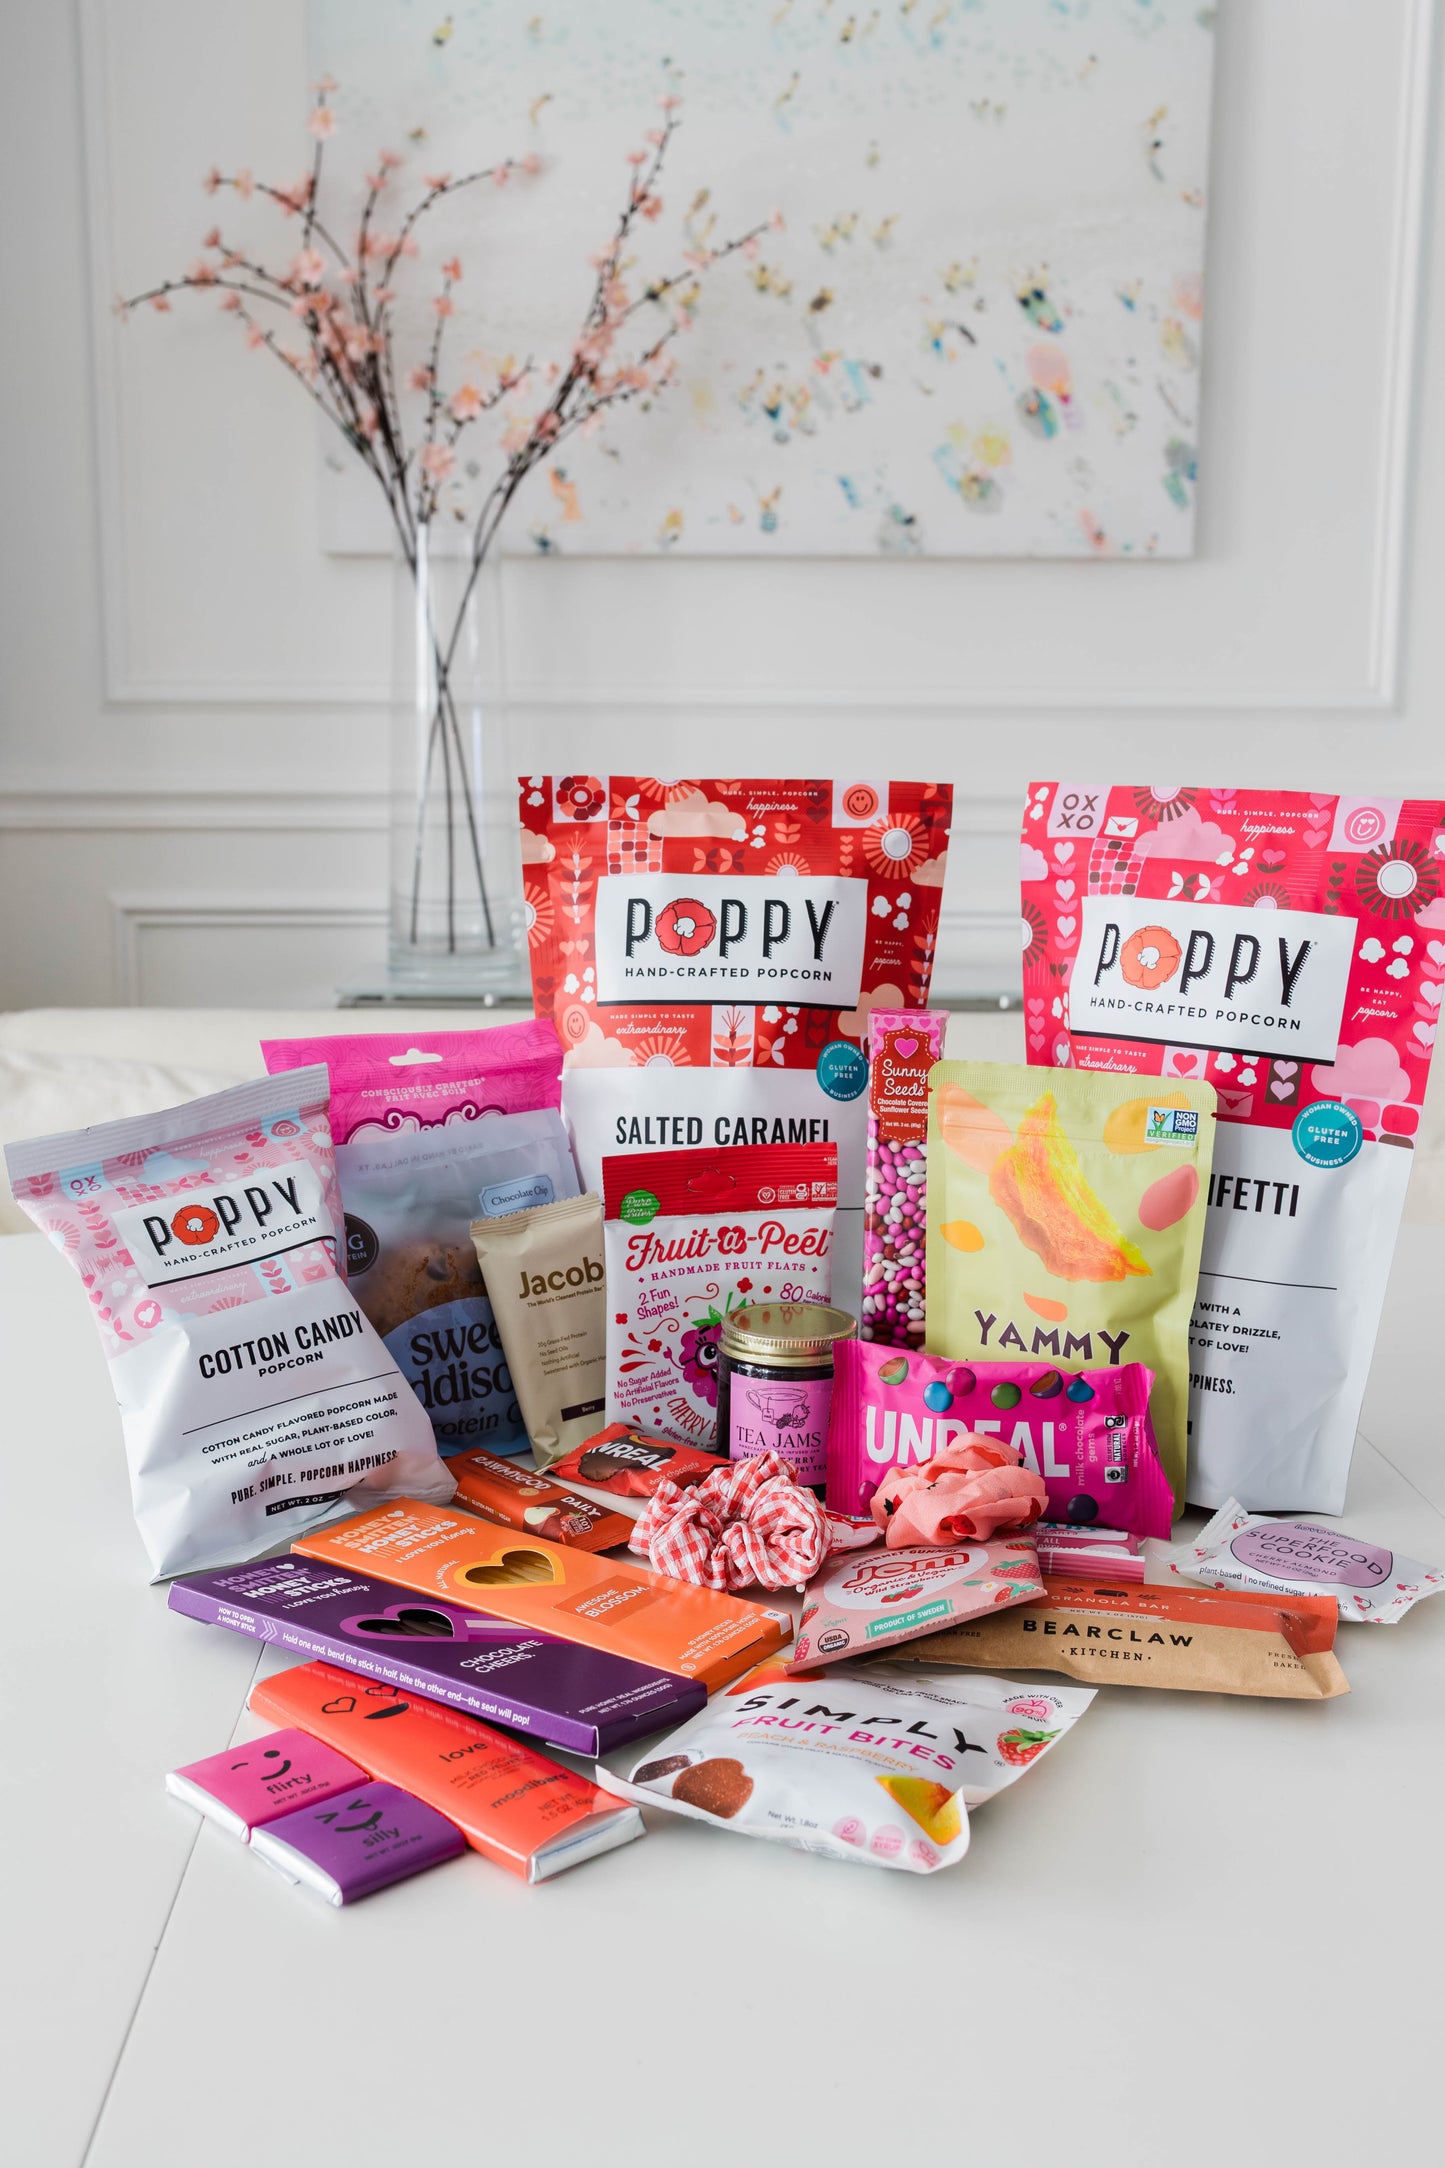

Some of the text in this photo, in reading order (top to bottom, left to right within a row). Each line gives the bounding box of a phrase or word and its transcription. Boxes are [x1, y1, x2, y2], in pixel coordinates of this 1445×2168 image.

[1280, 811, 1319, 819] POPCORN
[1241, 820, 1295, 841] happiness
[626, 898, 835, 962] POPPY
[626, 966, 832, 981] HAND-CRAFTED POPCORN
[1094, 923, 1311, 1008] POPPY
[1090, 997, 1301, 1031] HAND-CRAFTED POPCORN
[1352, 1006, 1398, 1021] popcorn
[616, 1021, 687, 1044] extraordinary
[882, 1059, 928, 1084] Sunny
[361, 1085, 433, 1098] CONSCIOUSLY
[884, 1078, 924, 1096] Seeds
[878, 1098, 906, 1106] Chocolate
[1175, 1119, 1196, 1127] GMO
[1177, 1112, 1196, 1120] NON
[1302, 1103, 1358, 1127] WOMAN OWNED
[616, 1116, 702, 1145] SALTED
[1150, 1131, 1193, 1140] VERIFIED
[1308, 1127, 1348, 1138] GLUTEN
[1314, 1136, 1340, 1145] FREE
[1305, 1153, 1343, 1166] BUSINESS
[491, 1185, 548, 1206] Chocolate Chip
[143, 1177, 303, 1256] POPPY
[164, 1216, 317, 1267] HAND-CRAFTED POPCORN
[519, 1257, 604, 1299] Jacob
[651, 1261, 805, 1281] HANDMADE FRUIT FLATS
[639, 1287, 671, 1306] 2 Fun
[780, 1283, 803, 1303] 80
[637, 1296, 679, 1320] Shapes!
[1200, 1302, 1229, 1313] WITH
[410, 1322, 503, 1366] swee
[974, 1310, 1130, 1365] YAMMY
[1233, 1326, 1281, 1340] DRIZZLE,
[199, 1311, 364, 1379] COTTON CANDY
[1198, 1339, 1249, 1353] OF LOVE!
[258, 1351, 324, 1377] POPCORN
[626, 1385, 654, 1397] Artificial
[655, 1378, 679, 1389] Flavors
[629, 1376, 648, 1386] Sugar
[651, 1368, 671, 1380] Added
[632, 1389, 677, 1405] Preservatives
[202, 1392, 398, 1454] COTTON CANDY FLAVORED POPCORN MADE
[433, 1407, 499, 1436] rotein
[667, 1398, 711, 1436] CHERRY
[212, 1409, 398, 1465] WITH REAL SUGAR, PLANT-BASED COLOR,
[662, 1427, 698, 1446] gluten-free
[736, 1426, 821, 1448] TEA JAMS
[1089, 1433, 1097, 1462] gems
[248, 1430, 374, 1468] and A WHOLE LOT OF LOVE!
[1075, 1410, 1085, 1486] milk chocolate
[231, 1450, 398, 1504] PURE. SIMPLE. POPCORN HAPPINESS.
[561, 1496, 601, 1517] DAILY
[329, 1516, 393, 1544] HONEY
[345, 1515, 422, 1549] SMITTEN
[358, 1524, 421, 1553] HONEY
[396, 1521, 457, 1547] STICKS
[1246, 1531, 1383, 1574] SUPERFOOD
[1308, 1537, 1341, 1547] THE
[1261, 1543, 1352, 1568] COOKIE
[212, 1567, 281, 1587] HONEY
[228, 1568, 310, 1593] SMITTEN
[243, 1577, 313, 1598] HONEY
[283, 1577, 352, 1597] STICKS
[1200, 1567, 1242, 1580] plant-based
[1259, 1580, 1284, 1591] refined
[1285, 1588, 1304, 1596] sugar
[575, 1589, 618, 1613] AWESOME
[584, 1585, 649, 1617] BLOSSOM.
[1052, 1596, 1169, 1610] GRANOLA BAR
[219, 1607, 231, 1615] HOW
[239, 1613, 255, 1623] OPEN
[223, 1618, 240, 1627] HONEY
[241, 1622, 256, 1632] STICK
[874, 1617, 904, 1631] PRODUCT
[917, 1604, 945, 1618] SWEDEN
[824, 1634, 842, 1642] USDA
[1023, 1619, 1193, 1647] BEARCLAW
[460, 1640, 543, 1668] CHOCOLATE
[822, 1640, 846, 1650] ORGANIC
[1070, 1648, 1142, 1660] KITCHEN
[475, 1653, 536, 1673] CHEERS.
[283, 1633, 298, 1644] Hold
[312, 1645, 326, 1654] end,
[327, 1648, 345, 1660] bend
[346, 1655, 357, 1665] the
[358, 1660, 374, 1671] stick
[376, 1664, 382, 1672] in
[383, 1667, 398, 1680] half,
[400, 1672, 413, 1684] bite
[414, 1678, 425, 1689] the
[427, 1684, 446, 1695] other
[481, 1701, 497, 1713] seal
[498, 1708, 512, 1718] will
[512, 1712, 529, 1725] pop!
[735, 1695, 987, 1754] SIMPLY
[439, 1742, 488, 1762] love
[731, 1715, 843, 1736] FRUIT
[848, 1731, 956, 1770] BITES
[737, 1732, 795, 1742] PEACH
[814, 1741, 921, 1772] RASPBERRY
[266, 1773, 312, 1794] flirty
[363, 1827, 400, 1847] silly
